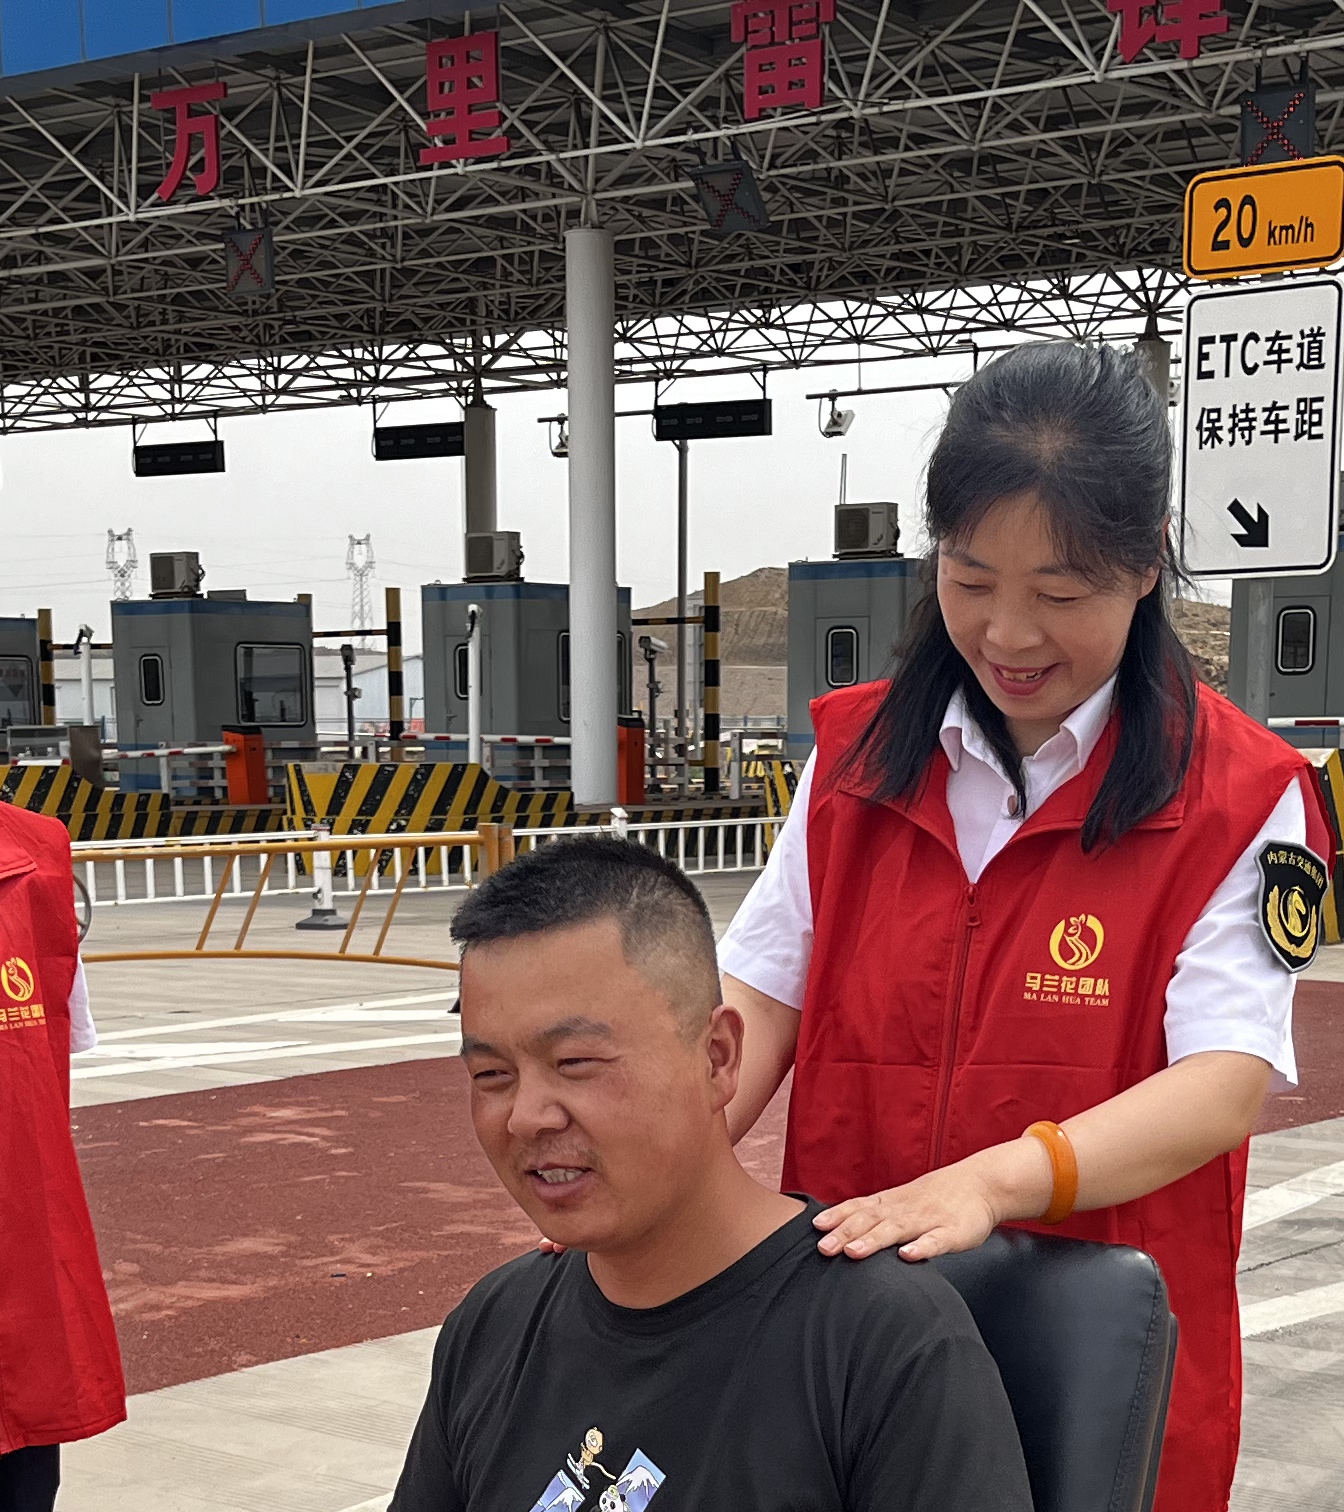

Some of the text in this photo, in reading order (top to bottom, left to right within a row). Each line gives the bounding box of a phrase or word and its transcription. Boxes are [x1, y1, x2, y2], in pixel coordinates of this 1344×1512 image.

[1211, 194, 1315, 252] 20 km/h
[1196, 325, 1327, 380] ETC车道
[1195, 396, 1325, 450] 保持车距
[1023, 991, 1110, 1007] MA LAN HUA TEAM
[1024, 972, 1110, 997] 马兰花团队
